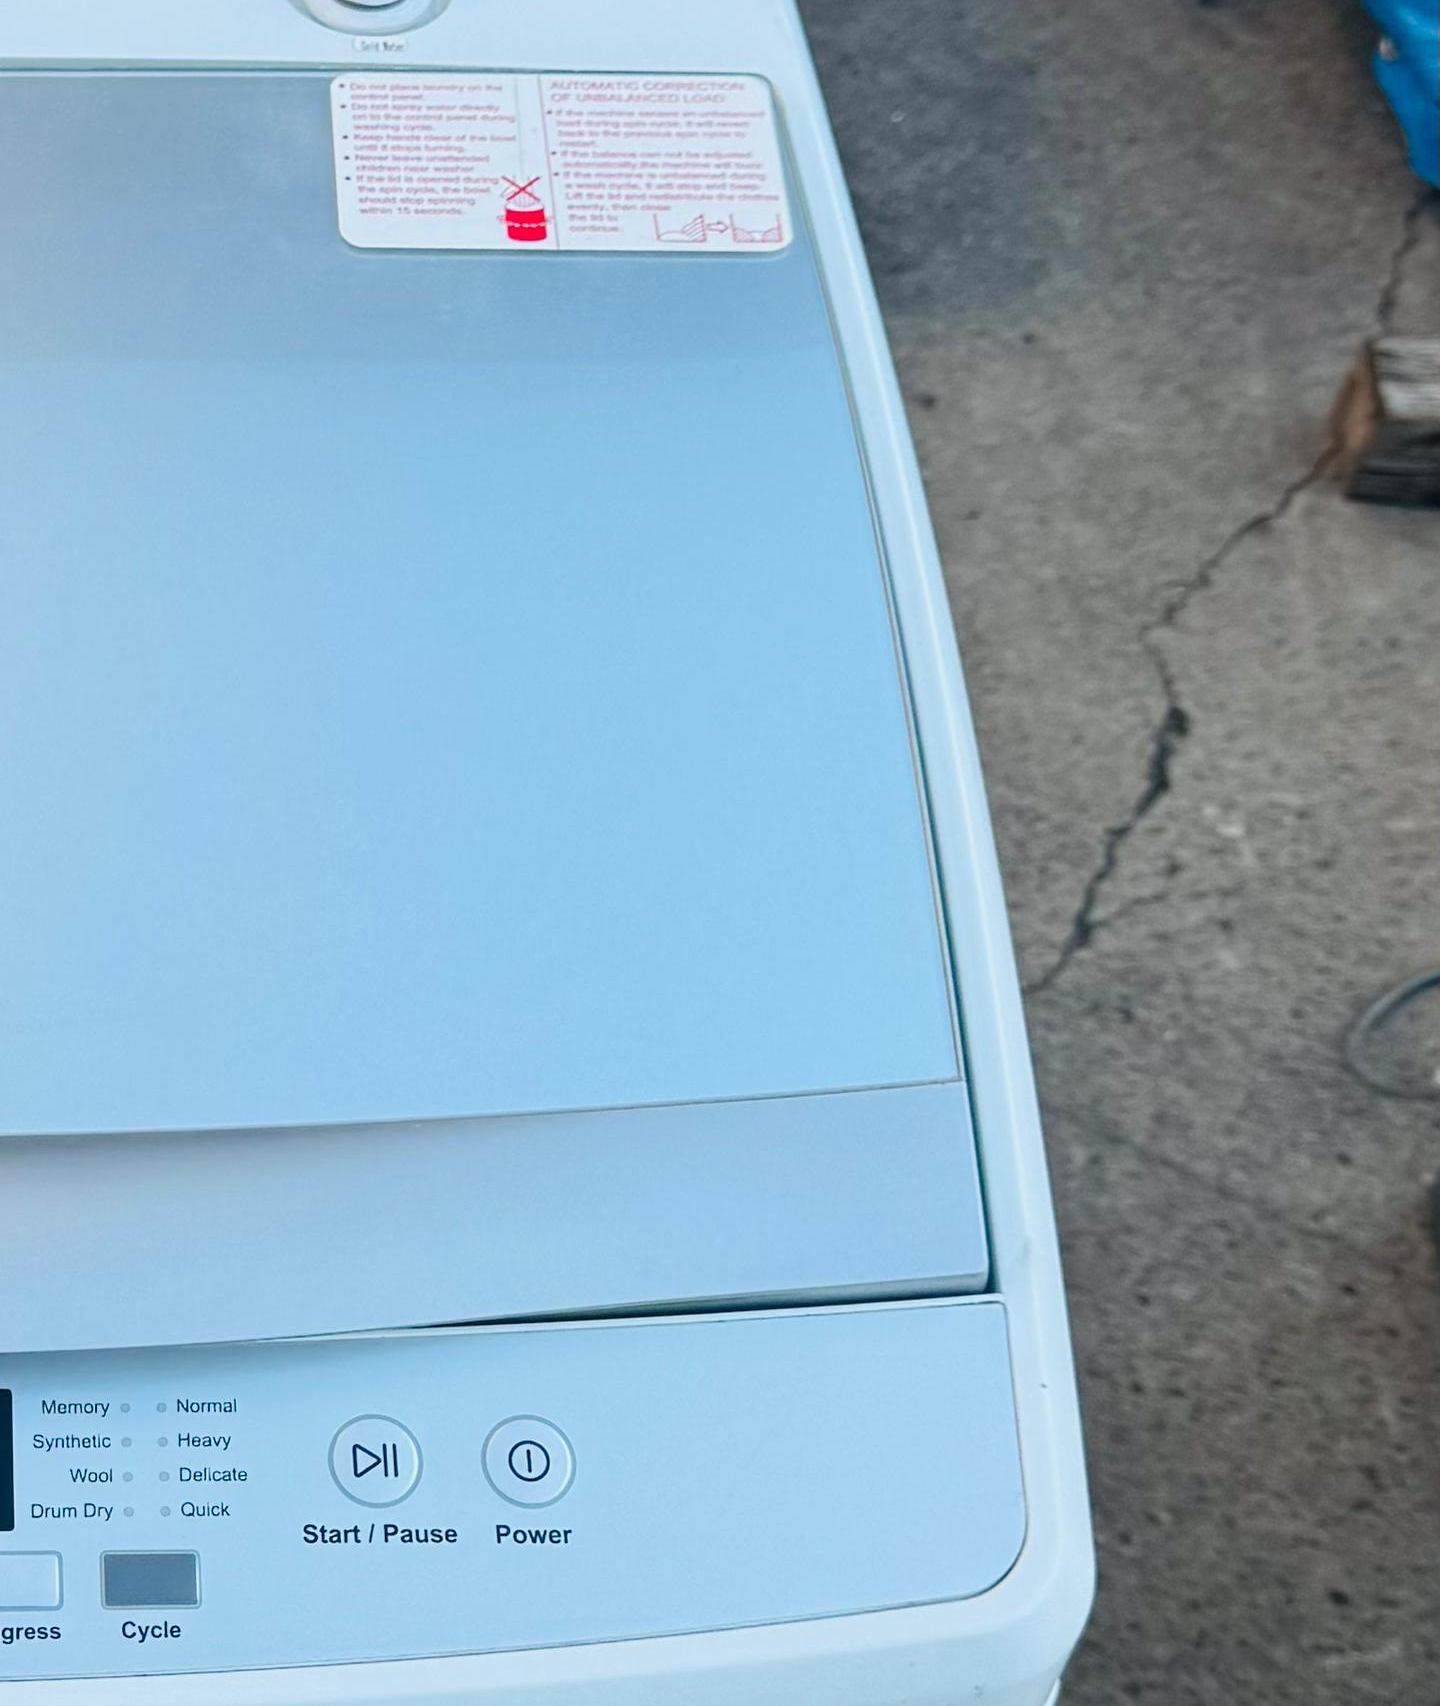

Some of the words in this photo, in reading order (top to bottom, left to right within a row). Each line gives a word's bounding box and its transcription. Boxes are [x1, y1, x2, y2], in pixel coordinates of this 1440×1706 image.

[41, 1399, 110, 1418] Memory
[176, 1398, 237, 1414] Normal
[32, 1433, 112, 1453] Synthetic
[178, 1432, 232, 1451] Heavy
[69, 1468, 113, 1483] Wool
[179, 1466, 248, 1482] Delicate
[31, 1503, 78, 1519] Drum
[83, 1502, 114, 1522] Dry
[180, 1501, 231, 1518] Quick
[303, 1523, 362, 1544] Start
[368, 1523, 375, 1544] /
[383, 1523, 458, 1544] Pause
[495, 1524, 573, 1545] Power
[121, 1620, 182, 1644] Cycle
